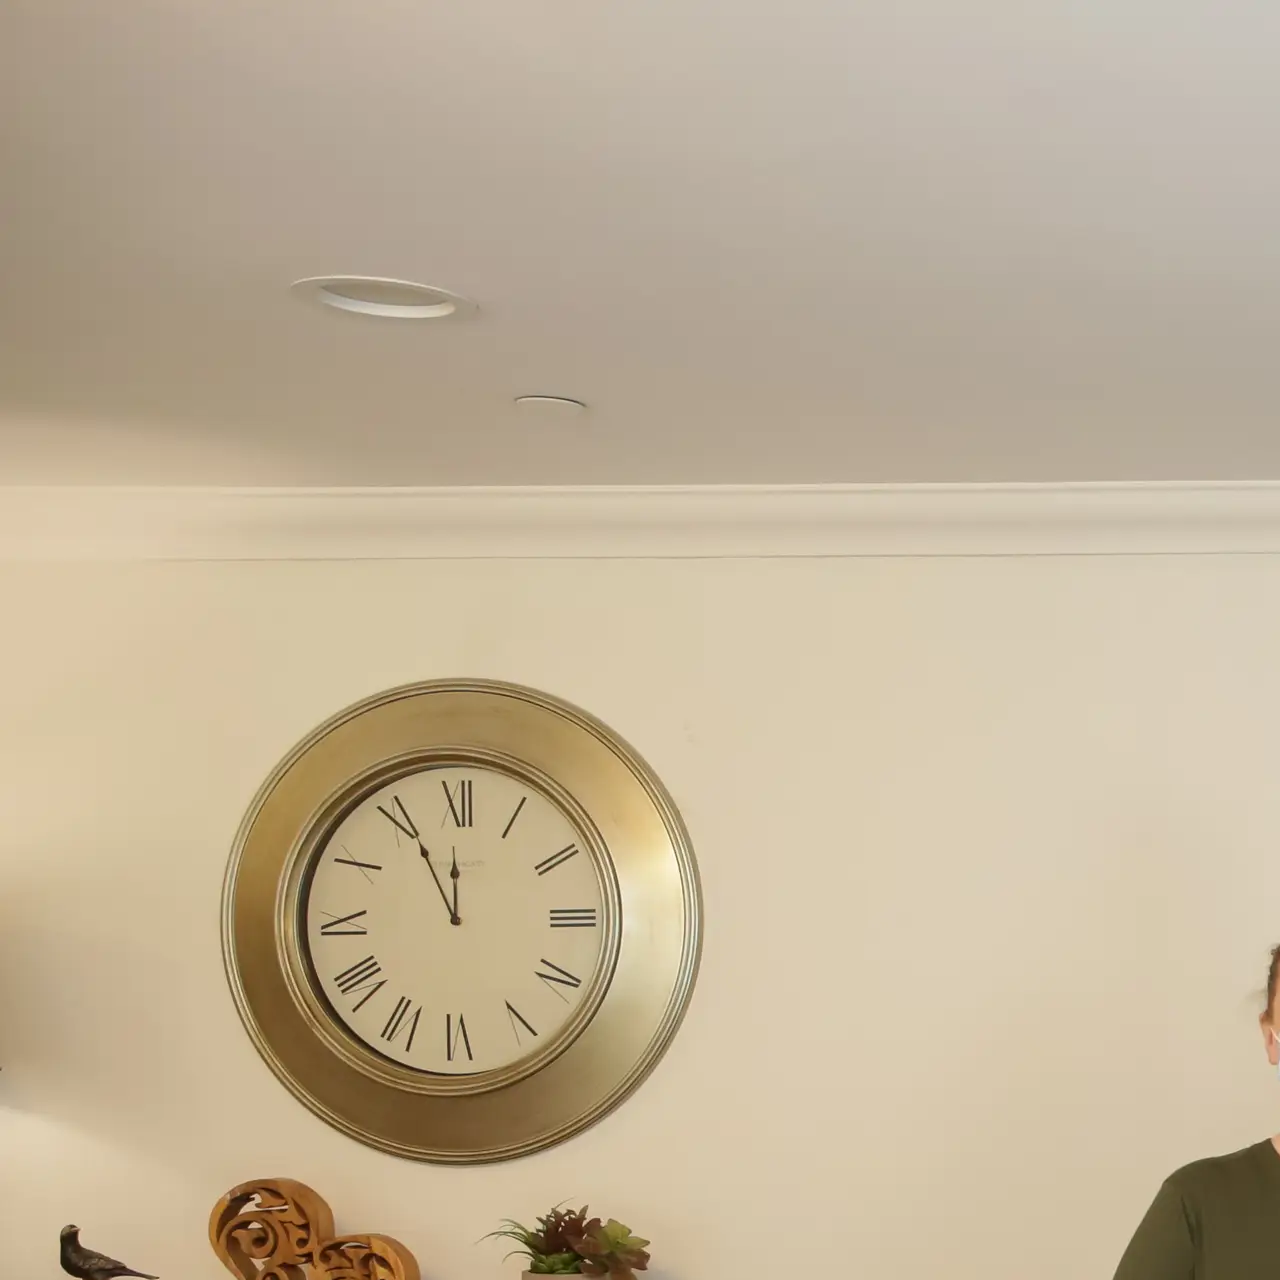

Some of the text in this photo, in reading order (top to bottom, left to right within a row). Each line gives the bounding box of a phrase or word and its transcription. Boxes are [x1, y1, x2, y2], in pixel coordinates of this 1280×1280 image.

[376, 795, 420, 848] XI
[441, 780, 473, 829] XII
[501, 796, 527, 838] I
[334, 844, 382, 884] X
[534, 843, 580, 876] II
[320, 910, 368, 936] IX
[549, 908, 597, 928] III
[334, 955, 388, 1013] VIII
[534, 958, 582, 1004] IV
[380, 996, 423, 1053] VII
[446, 1013, 474, 1061] VI
[504, 1000, 539, 1046] V
